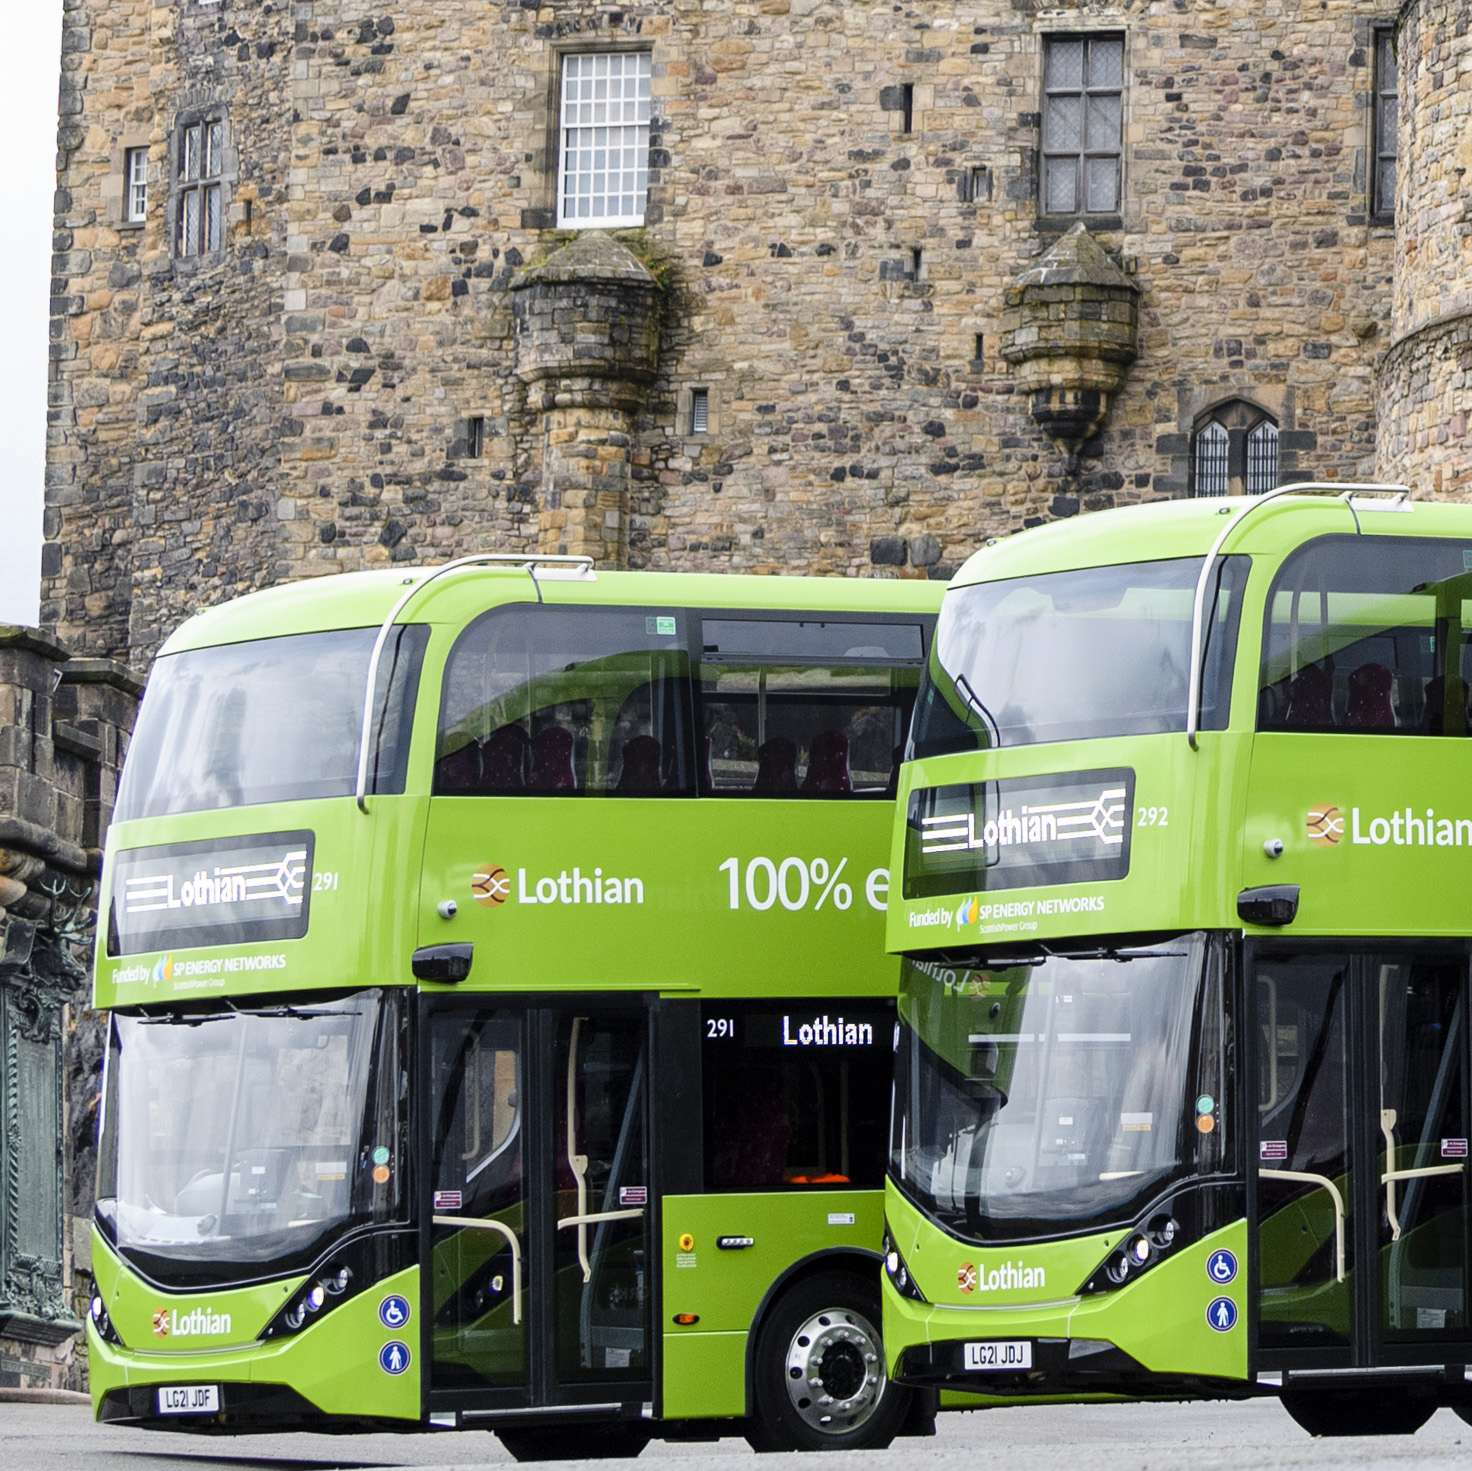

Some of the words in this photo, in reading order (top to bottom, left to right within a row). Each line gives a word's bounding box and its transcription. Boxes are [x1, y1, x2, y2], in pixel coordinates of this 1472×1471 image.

[968, 805, 1058, 849] Lothian
[1137, 807, 1168, 827] 292
[167, 867, 248, 908] Lothian
[313, 872, 338, 892] 291
[518, 867, 644, 904] Lothian
[718, 857, 853, 911] 100%
[909, 909, 939, 928] Funded
[940, 908, 953, 929] by
[979, 905, 993, 920] SP
[994, 901, 1035, 918] ENERGY
[1036, 896, 1105, 915] NETWORKS
[1019, 921, 1038, 931] Group
[112, 964, 139, 984] Funded
[140, 963, 151, 984] by
[173, 963, 186, 976] SP
[187, 959, 223, 975] ENERGY
[224, 954, 287, 972] NETWORKS
[707, 1019, 734, 1037] 291
[783, 1015, 873, 1045] Lothian
[979, 1260, 1045, 1291] Lothian
[172, 1307, 231, 1336] Lothian
[972, 1345, 997, 1365] LG21
[1001, 1345, 1023, 1364] JDJ
[166, 1390, 188, 1408] LG21
[192, 1389, 210, 1407] JDF
